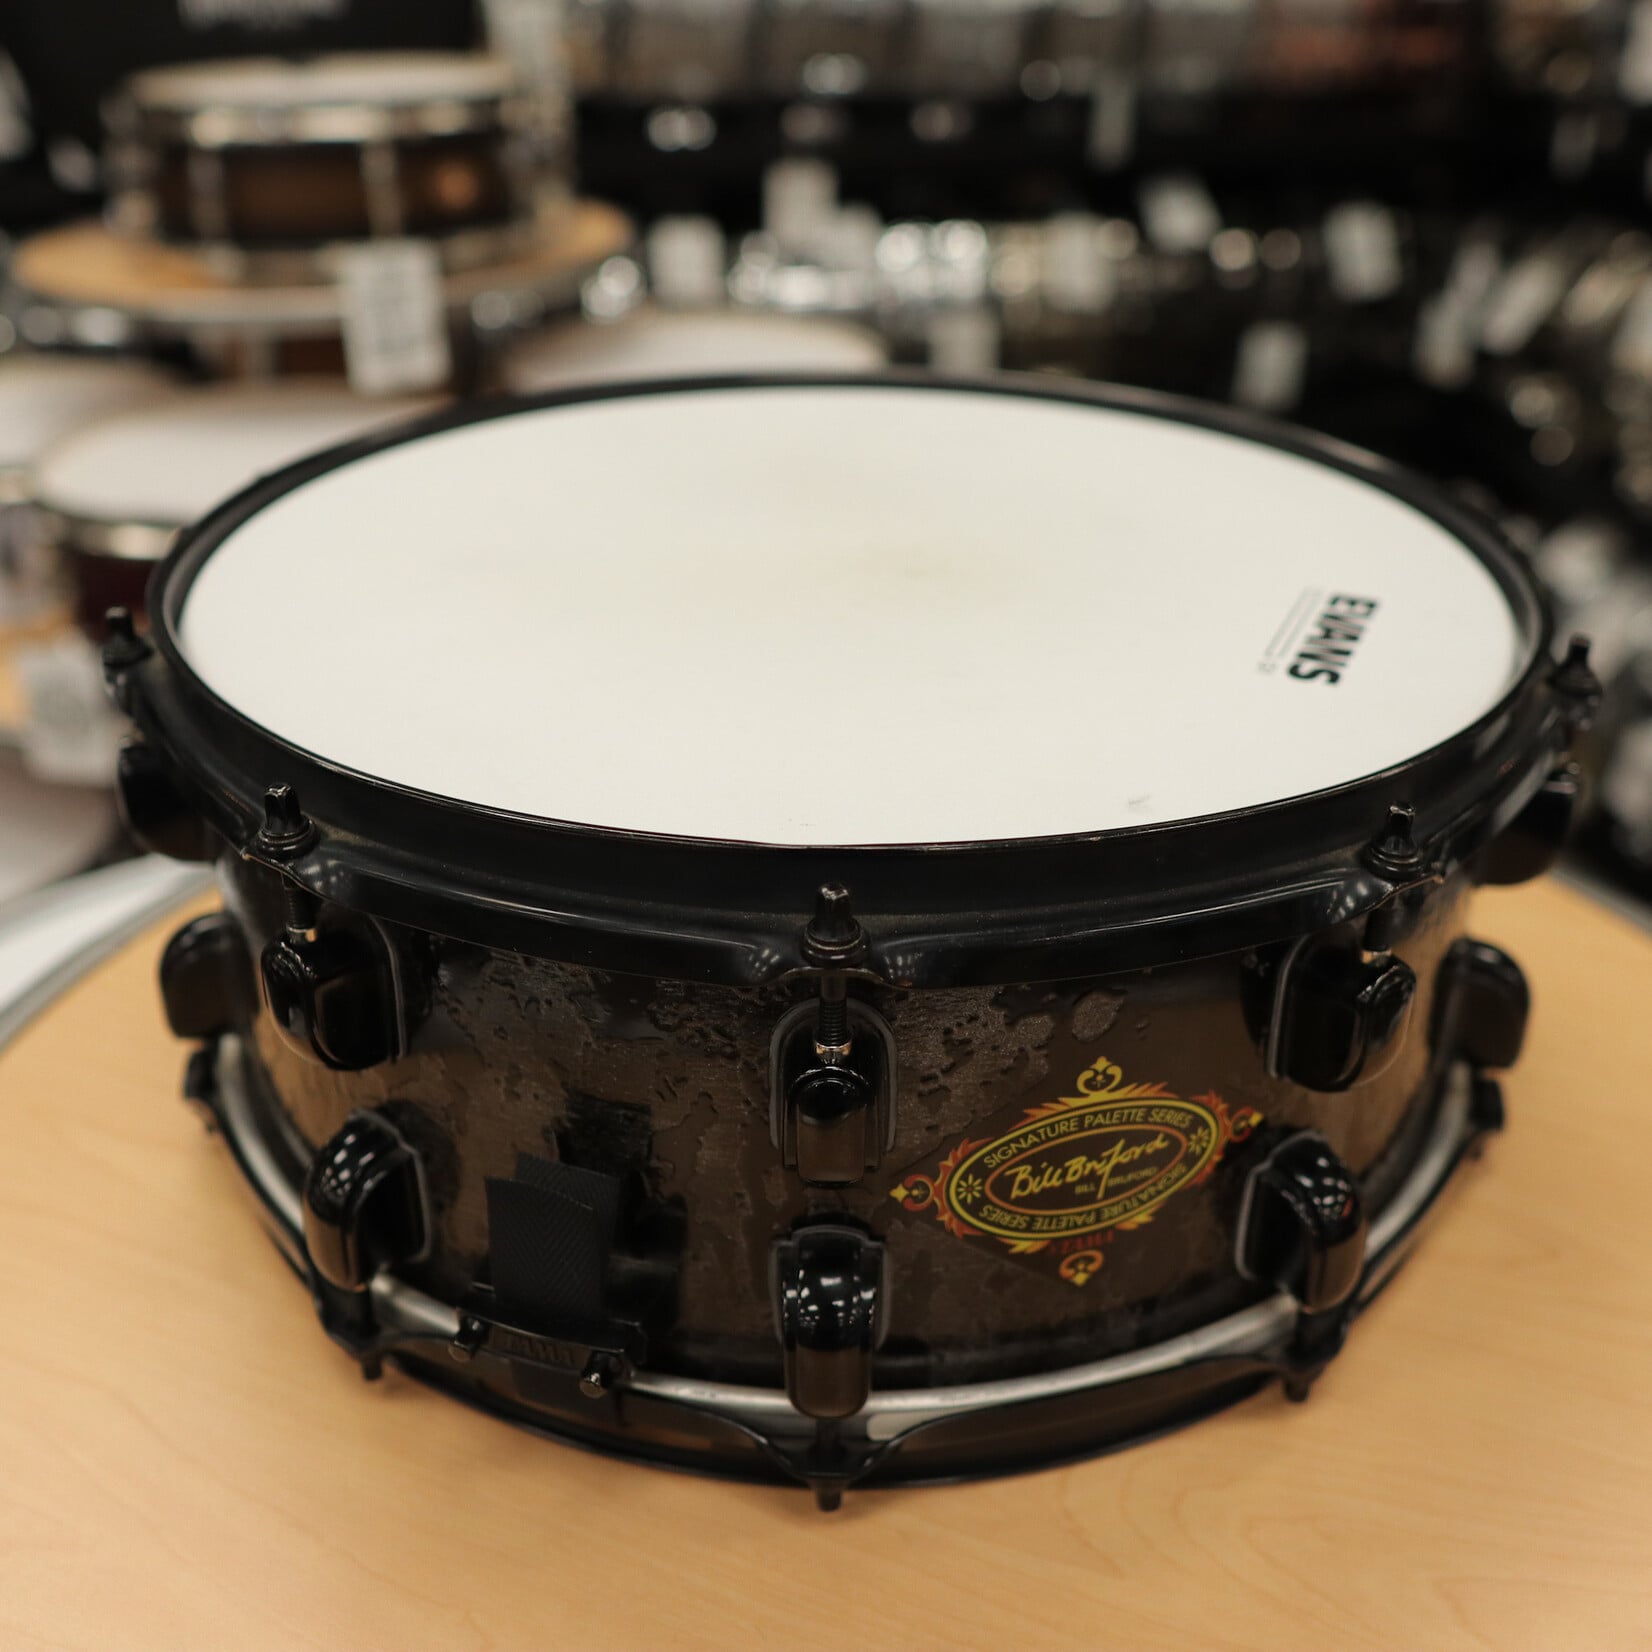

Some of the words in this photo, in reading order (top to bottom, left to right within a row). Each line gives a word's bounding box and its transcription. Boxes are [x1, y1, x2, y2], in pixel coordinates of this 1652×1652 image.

[1288, 594, 1378, 685] EVANS
[983, 1118, 1079, 1168] SIGNATURE
[1084, 1107, 1145, 1129] PALETTE
[1148, 1108, 1194, 1130] SERIES
[980, 1204, 1029, 1230] SERIES
[1032, 1211, 1097, 1232] PALETTE
[1101, 1162, 1187, 1223] SIGNATURE
